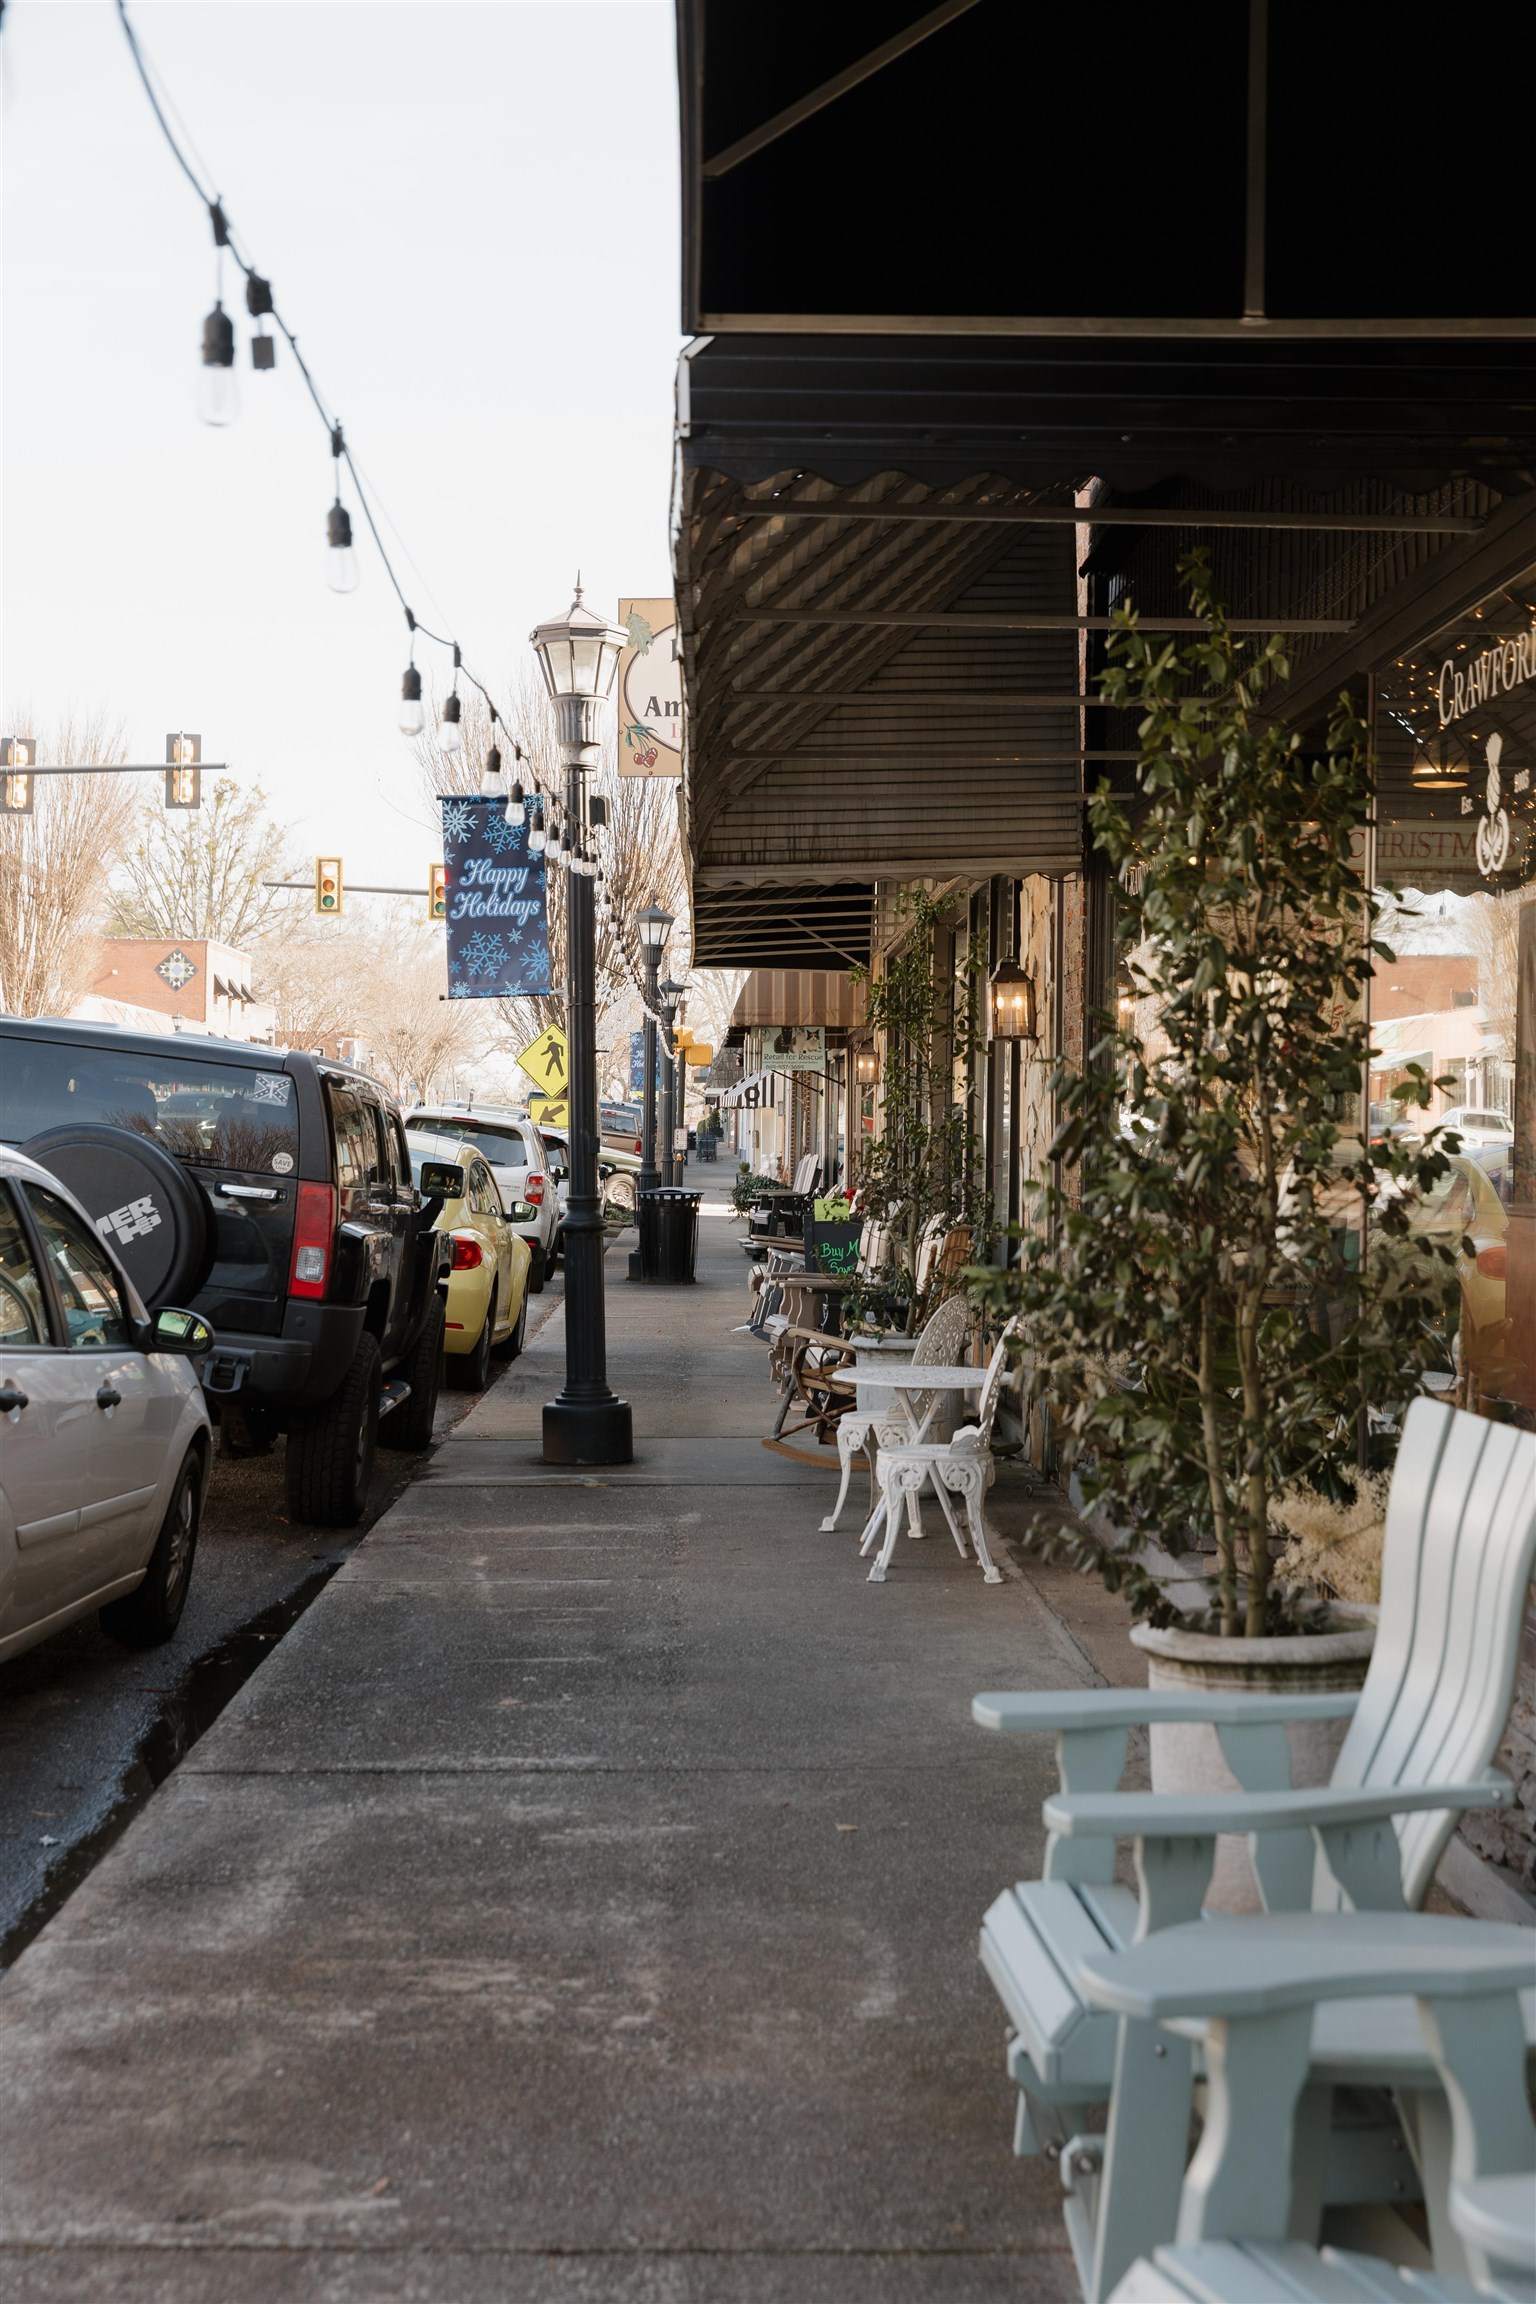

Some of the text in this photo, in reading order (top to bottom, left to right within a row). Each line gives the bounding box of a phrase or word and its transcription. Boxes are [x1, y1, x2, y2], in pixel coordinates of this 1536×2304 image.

[459, 858, 530, 894] Happy
[449, 890, 542, 927] Holidays
[764, 1053, 823, 1061] Retail for Rescue
[274, 1158, 292, 1168] SAVE
[820, 1242, 844, 1264] Buy
